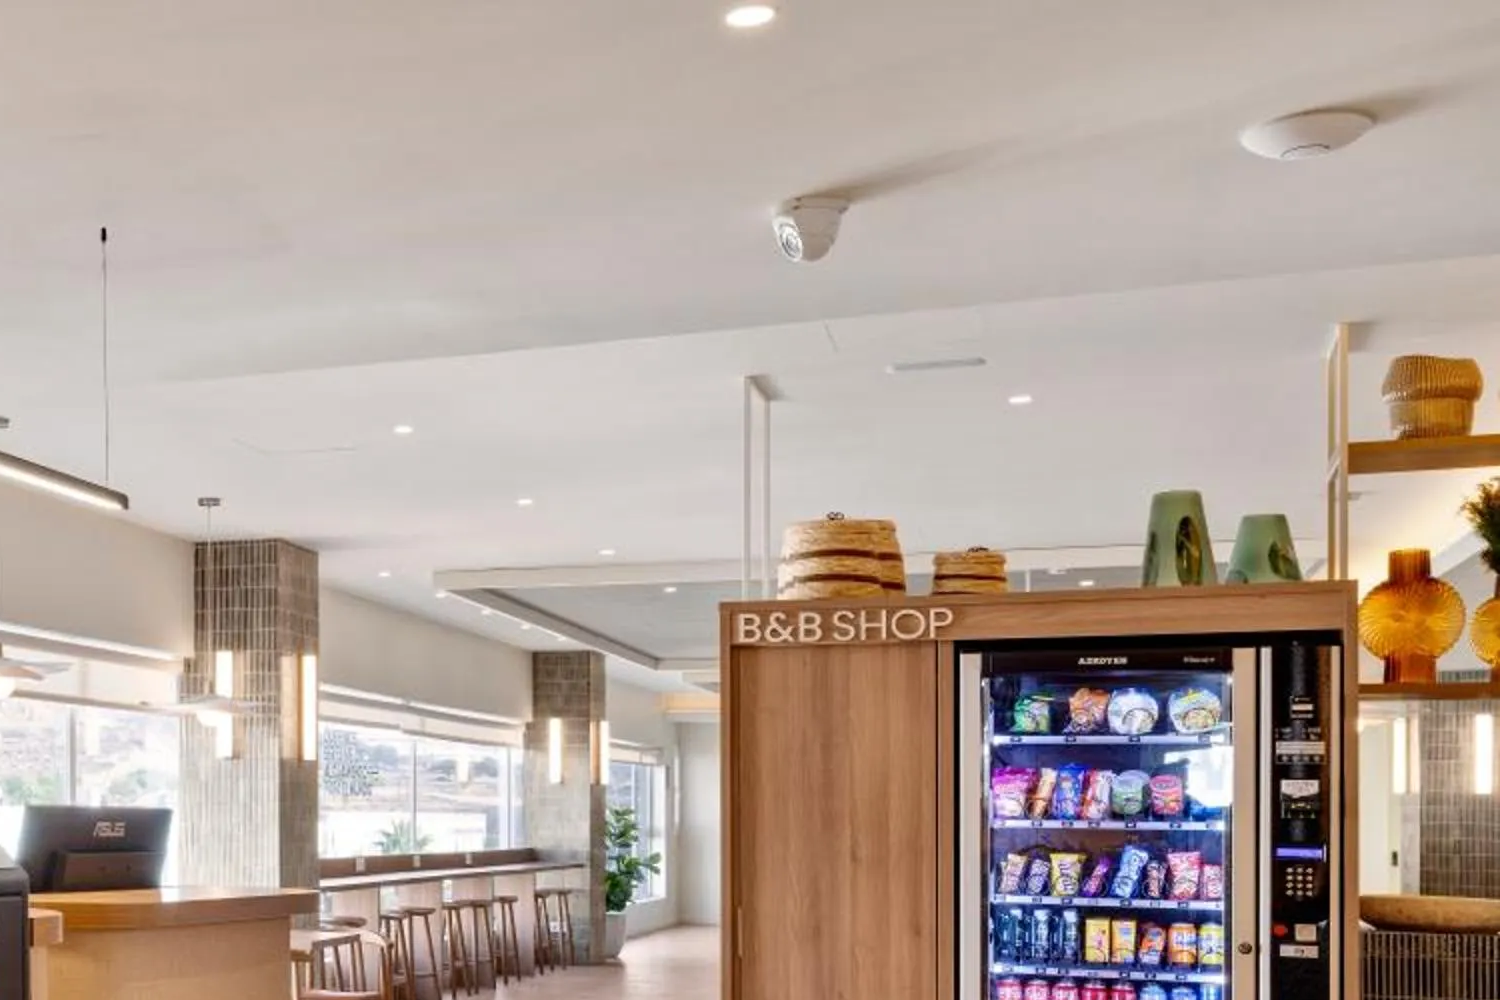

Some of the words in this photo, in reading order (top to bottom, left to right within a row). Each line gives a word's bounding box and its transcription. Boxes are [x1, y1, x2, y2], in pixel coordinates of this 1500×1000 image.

[737, 611, 823, 644] B&B
[832, 607, 954, 641] SHOP
[93, 821, 125, 837] ASUS
